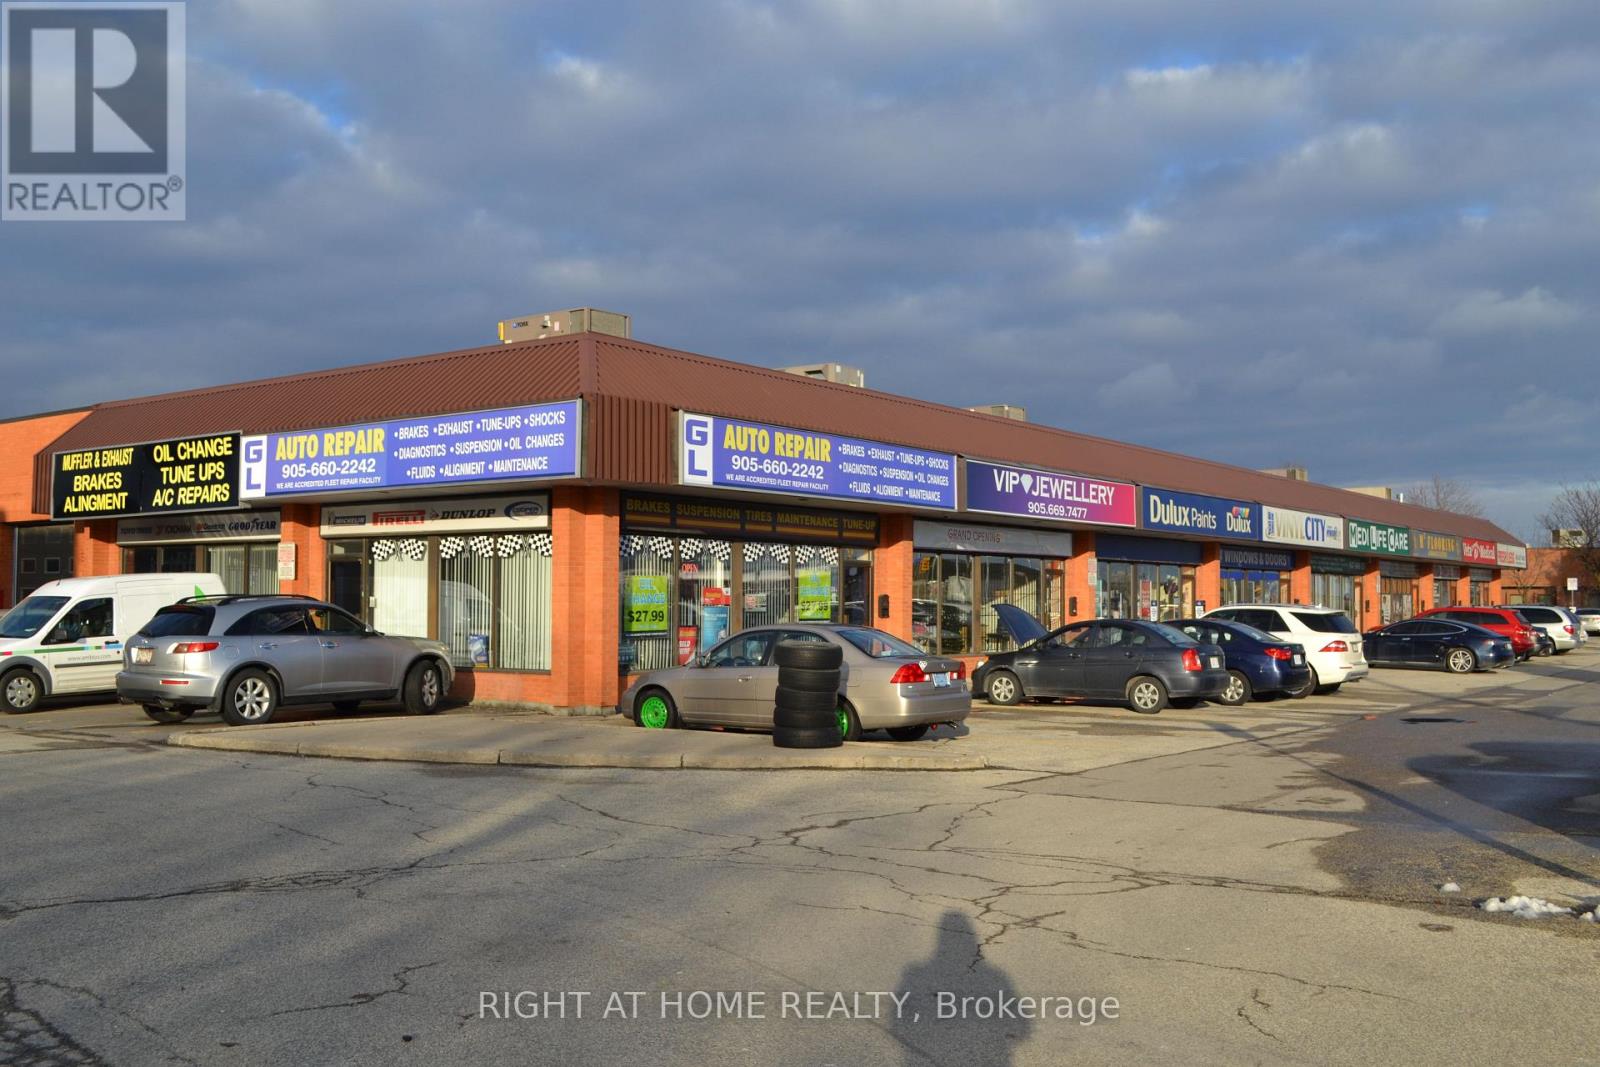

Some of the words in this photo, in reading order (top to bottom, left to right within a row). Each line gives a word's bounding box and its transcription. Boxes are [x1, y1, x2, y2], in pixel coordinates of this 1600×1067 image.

[399, 425, 429, 440] BRAKES
[438, 420, 474, 436] EXHAUST
[481, 415, 522, 432] TUNE-UPS
[529, 411, 566, 427] SHOCKS
[153, 444, 174, 463] OIL
[177, 436, 233, 460] CHANGE
[275, 434, 319, 461] AUTO
[323, 428, 385, 457] REPAIR
[399, 444, 446, 460] DIAGNOSTICS
[455, 439, 502, 455] SUSPENSION
[509, 436, 522, 450] OIL
[525, 433, 565, 449] CHANGES
[723, 424, 770, 454] AUTO
[774, 431, 832, 463] REPAIR
[62, 451, 92, 471] MUFFLER
[94, 451, 100, 467] &
[101, 448, 134, 466] EXHAUST
[410, 466, 435, 479] FLUIDS
[443, 461, 485, 477] ALIGNMENT
[493, 456, 548, 473] MAINTENANCE
[731, 454, 824, 480] 905-660-2242
[842, 443, 865, 457] BRAKES
[871, 448, 895, 461] EXHAUST
[900, 452, 925, 466] TUNE-UPS
[928, 457, 949, 470] SHOCKS
[160, 464, 195, 484] TUNE
[199, 461, 225, 481] UPS
[281, 458, 376, 479] 905-660-2242
[842, 462, 878, 476] DIAGNOSTICS
[882, 467, 914, 481] SUSPENSION
[917, 472, 925, 483] OIL
[927, 474, 949, 486] CHANGES
[73, 472, 122, 492] BRAKES
[294, 480, 324, 488] ACCREDITED
[325, 479, 339, 487] FLEET
[339, 477, 358, 486] REPAIR
[358, 476, 381, 485] FACILITY
[725, 473, 736, 481] WE
[736, 474, 746, 482] ARE
[746, 475, 777, 485] ACCREDITED
[777, 478, 791, 486] FLEET
[791, 479, 809, 489] REPAIR
[809, 481, 829, 490] FACILITY
[852, 481, 871, 494] FLUIDS
[876, 484, 903, 497] ALIGNMENT
[908, 488, 941, 502] MAINTENANCE
[993, 468, 1020, 493] VIP
[1031, 476, 1115, 506] JEWELLERY
[63, 492, 128, 513] ALINGMENT
[152, 488, 173, 507] A/C
[177, 483, 230, 505] REPAIRS
[372, 509, 426, 526] PIRELLI
[440, 508, 496, 520] DUNLOP
[626, 498, 671, 514] BRAKES
[676, 503, 740, 520] SUSPENSION
[745, 510, 773, 523] TIRES
[776, 513, 838, 528] MAINTENANCE
[842, 518, 876, 530] TUNE-UP
[1028, 501, 1088, 519] 905.669.7477
[1150, 494, 1190, 527] Dulux
[1191, 508, 1217, 530] Paints
[1226, 512, 1252, 534] Dulux
[1305, 517, 1326, 542] CITY
[947, 527, 972, 541] GRAND
[973, 530, 1001, 543] OPENING
[1349, 523, 1370, 548] MEDI
[1370, 525, 1387, 550] LIFE
[1388, 528, 1409, 552] CARE
[681, 563, 699, 574] OPEN
[1224, 550, 1259, 565] WINDOWS
[1265, 553, 1287, 567] DOORS
[627, 610, 665, 623] $27.99
